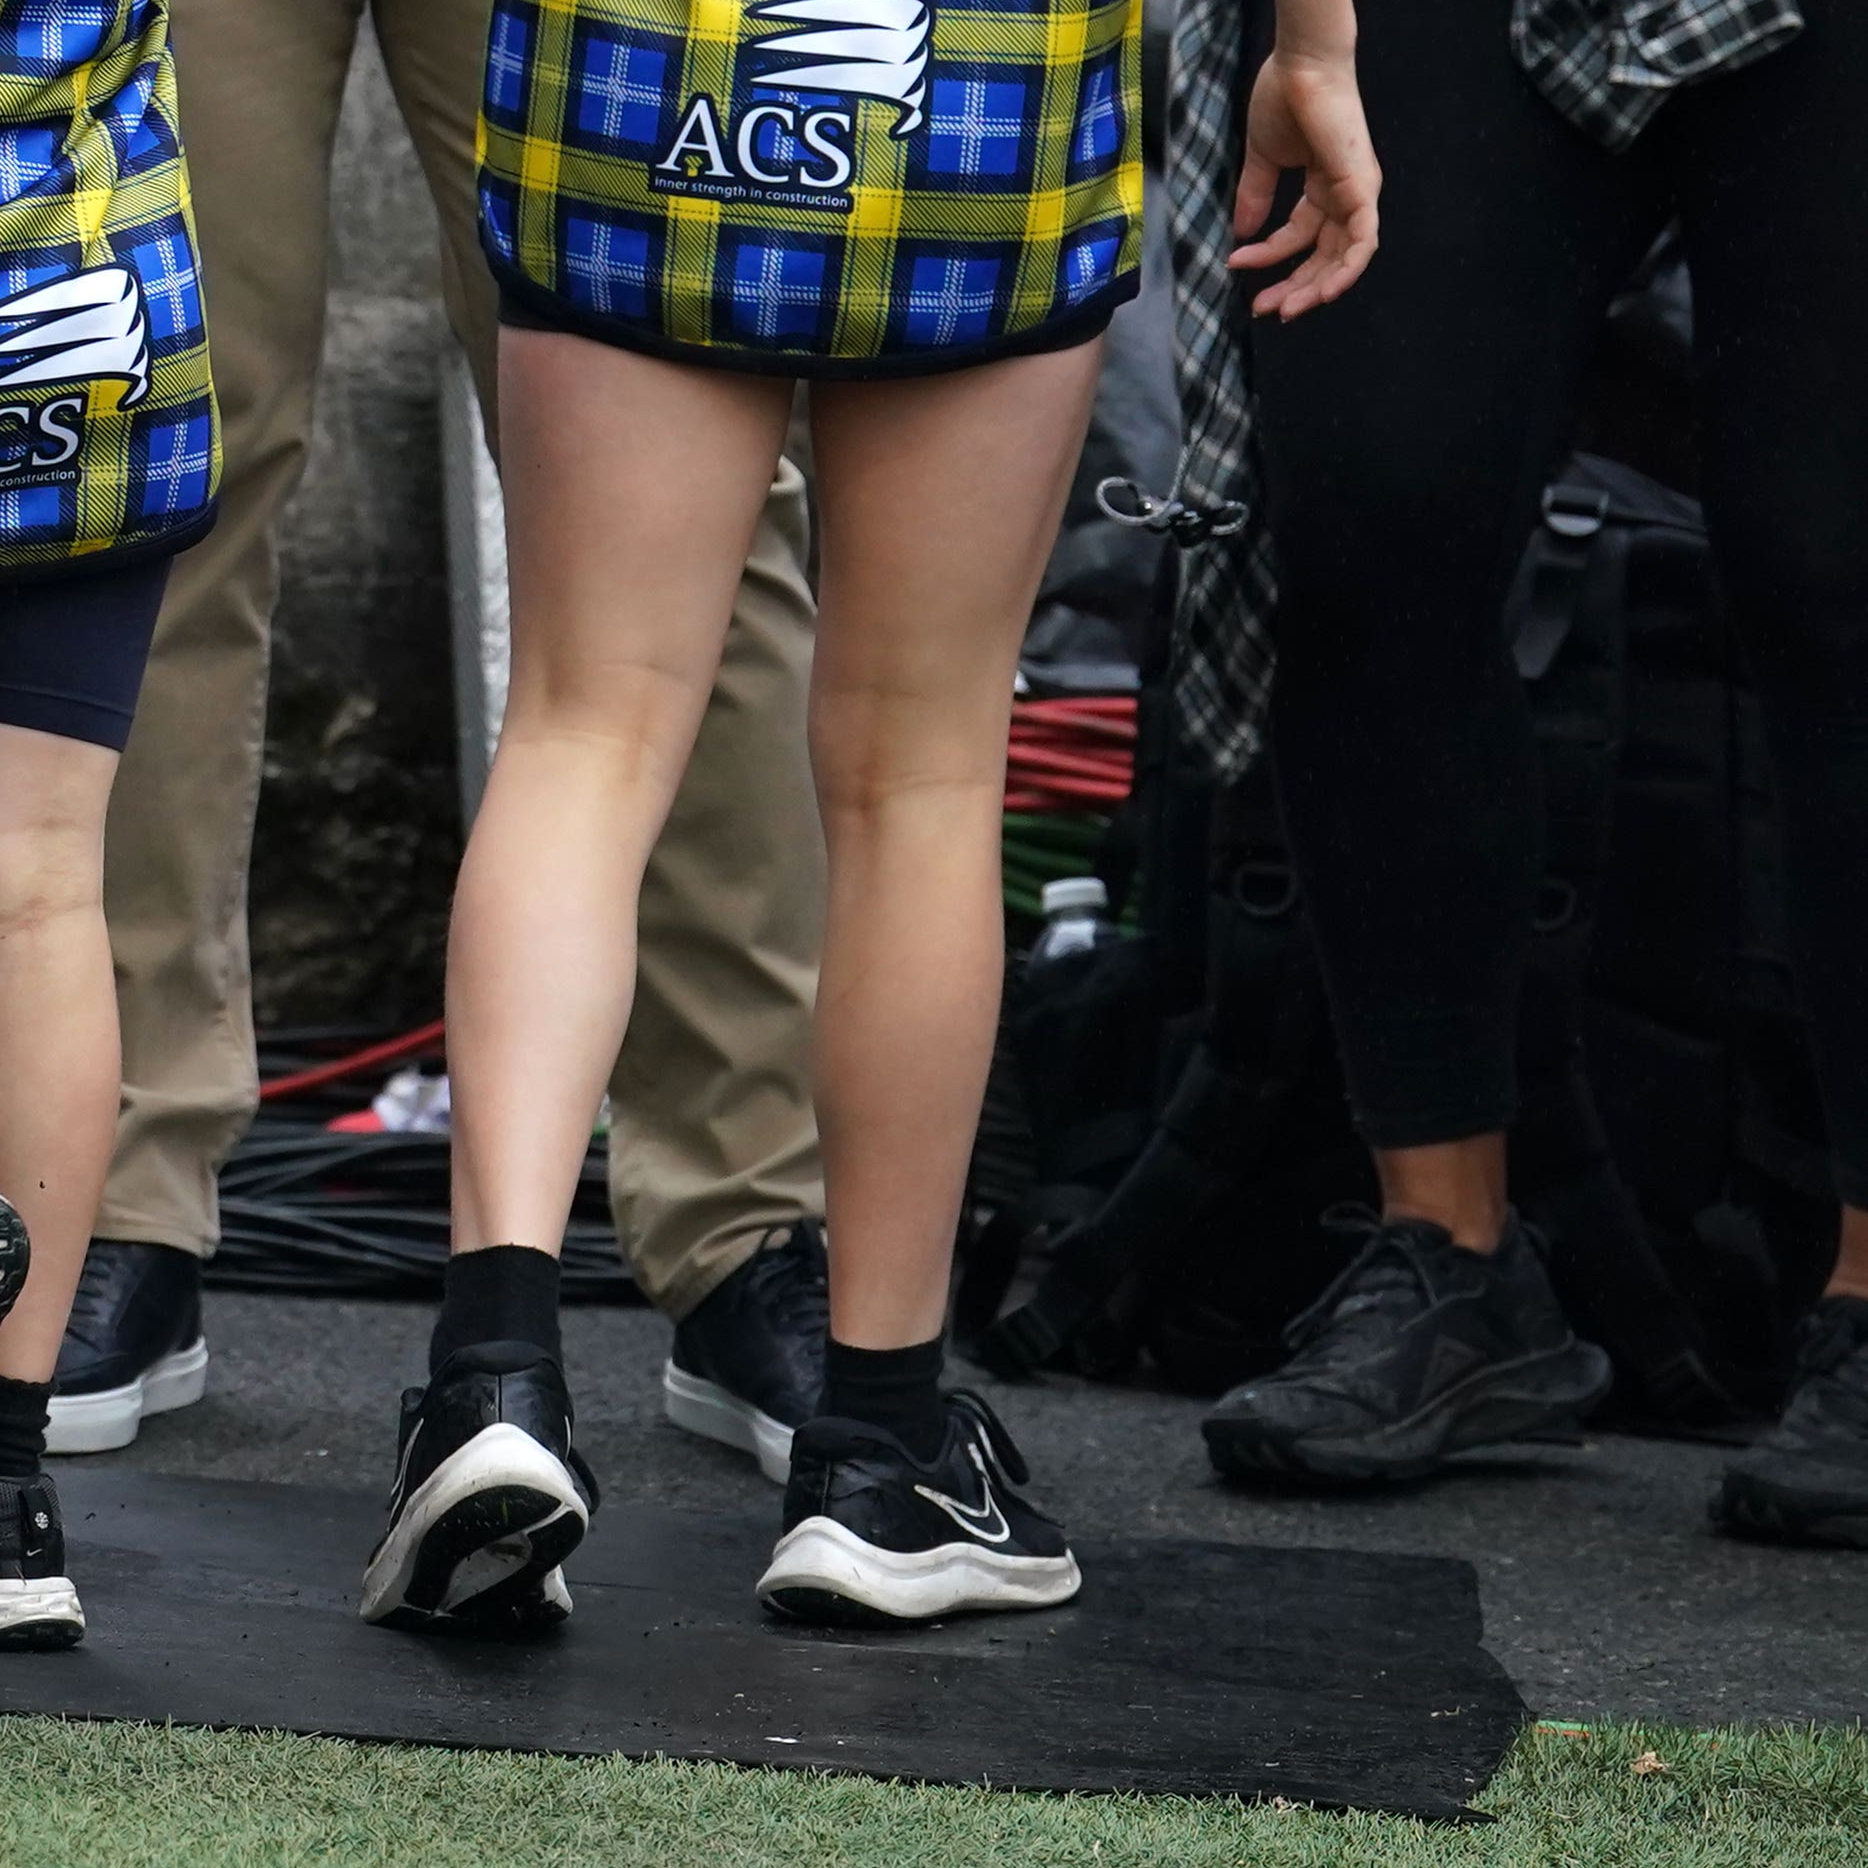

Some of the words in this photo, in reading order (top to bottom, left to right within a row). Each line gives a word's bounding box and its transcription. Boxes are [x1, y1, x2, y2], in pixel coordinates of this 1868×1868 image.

[656, 97, 851, 188] ACS
[654, 176, 687, 190] inner
[691, 182, 747, 199] strength
[750, 186, 763, 199] in
[765, 189, 849, 208] construction
[0, 469, 76, 487] construction
